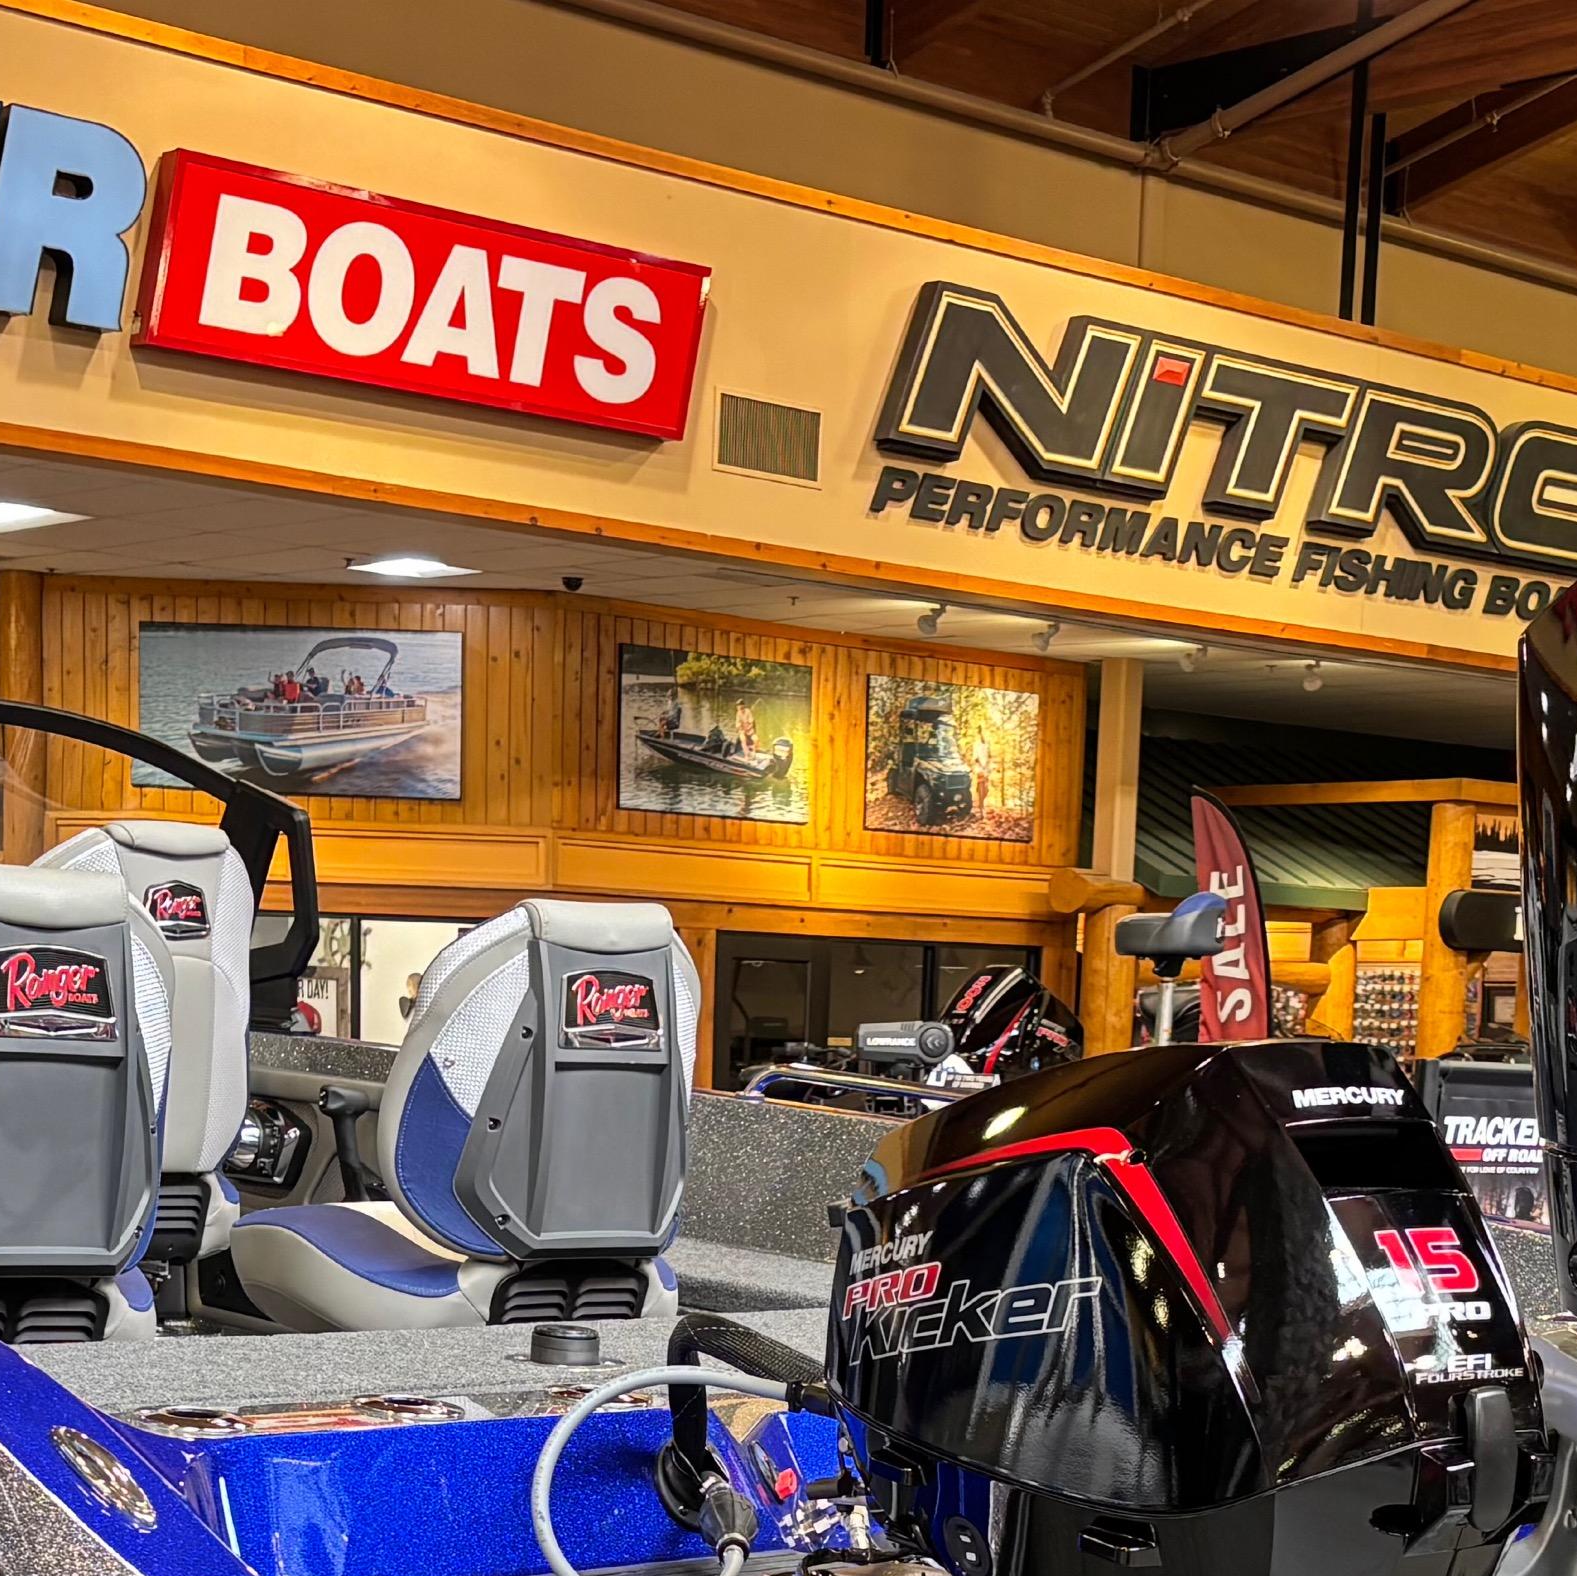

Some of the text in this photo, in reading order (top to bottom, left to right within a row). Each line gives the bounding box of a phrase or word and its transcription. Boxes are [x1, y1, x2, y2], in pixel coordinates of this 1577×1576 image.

[199, 193, 662, 405] BOATS
[869, 466, 1289, 578] PERFORMANCE
[1292, 543, 1477, 610] FISHING
[1209, 864, 1252, 1024] SALE
[0, 951, 99, 1012] Ranger
[307, 979, 329, 1000] DAY!
[571, 974, 650, 1026] Ranger
[866, 1037, 916, 1048] LOWRANCE
[1291, 1085, 1405, 1109] MERCURY
[1482, 1148, 1508, 1162] OFF
[849, 1230, 935, 1276] MERCURY
[1373, 1227, 1480, 1295] 15
[842, 1261, 942, 1322] PRO
[1423, 1301, 1493, 1322] PRO
[1446, 1352, 1493, 1373] EFI
